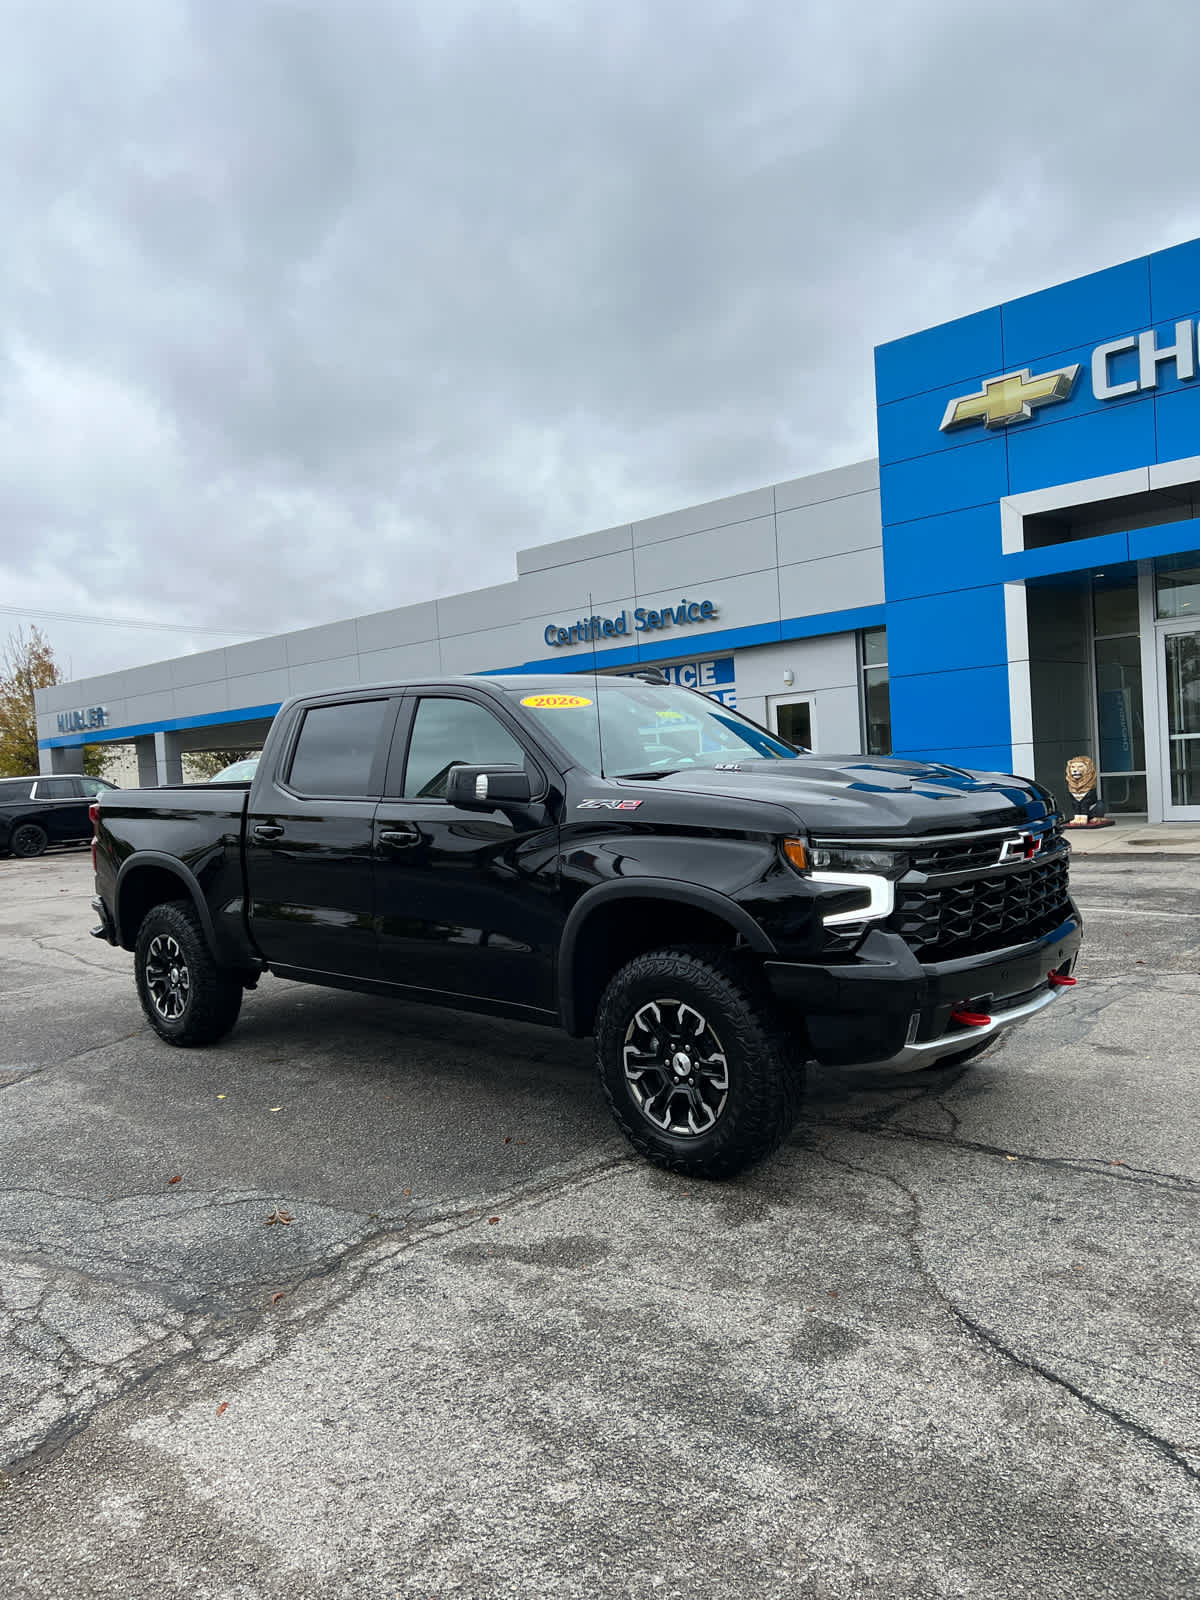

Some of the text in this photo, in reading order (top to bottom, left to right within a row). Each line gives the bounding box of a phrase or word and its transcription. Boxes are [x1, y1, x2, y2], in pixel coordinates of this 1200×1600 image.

[1092, 319, 1200, 400] CH
[544, 598, 714, 647] Certified Service
[533, 696, 581, 707] 2026
[575, 799, 644, 811] ZR2
